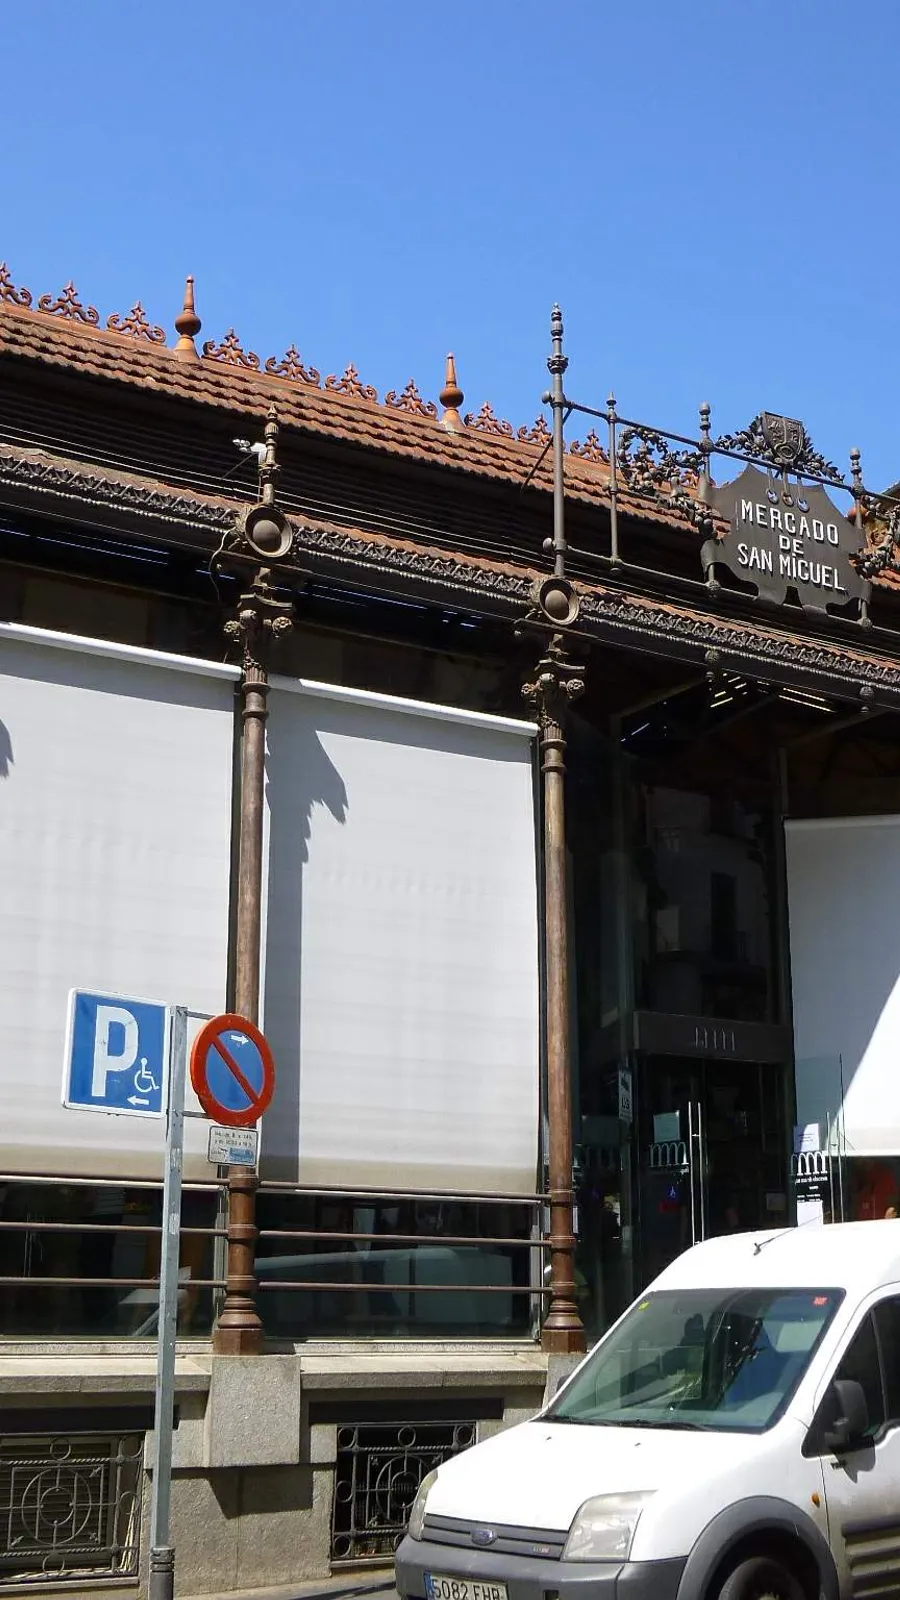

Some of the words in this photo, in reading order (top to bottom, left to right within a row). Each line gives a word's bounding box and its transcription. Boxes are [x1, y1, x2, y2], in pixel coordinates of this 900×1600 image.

[741, 499, 839, 545] MERCADO
[737, 543, 773, 572] SAN
[779, 534, 804, 555] DE
[91, 1005, 139, 1097] P
[433, 1579, 468, 1600] 5082
